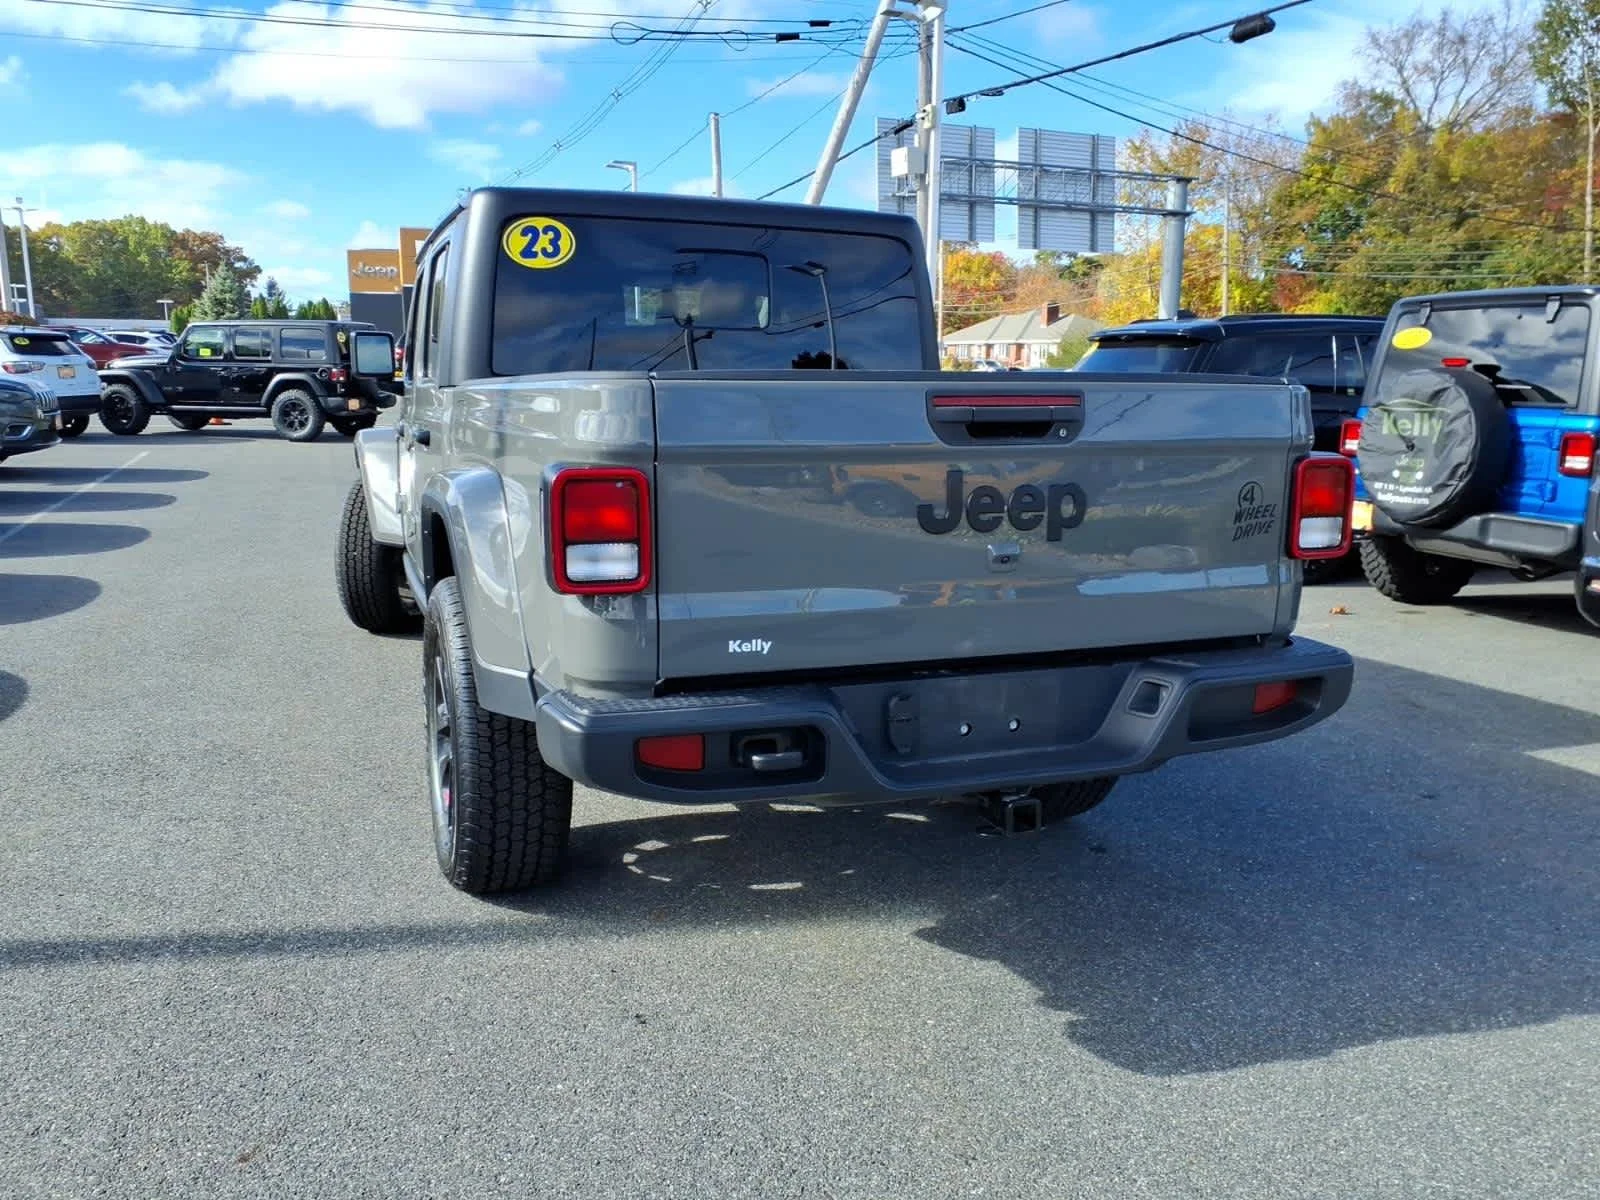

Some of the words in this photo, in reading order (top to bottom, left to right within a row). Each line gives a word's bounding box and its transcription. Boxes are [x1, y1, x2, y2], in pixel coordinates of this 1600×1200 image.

[519, 224, 562, 259] 23
[1382, 411, 1442, 445] Kelly
[917, 469, 1087, 542] Jeep
[1242, 485, 1256, 506] 4
[1233, 503, 1277, 525] WHEEL
[1232, 519, 1275, 541] DRIVE
[728, 638, 772, 655] Kelly
